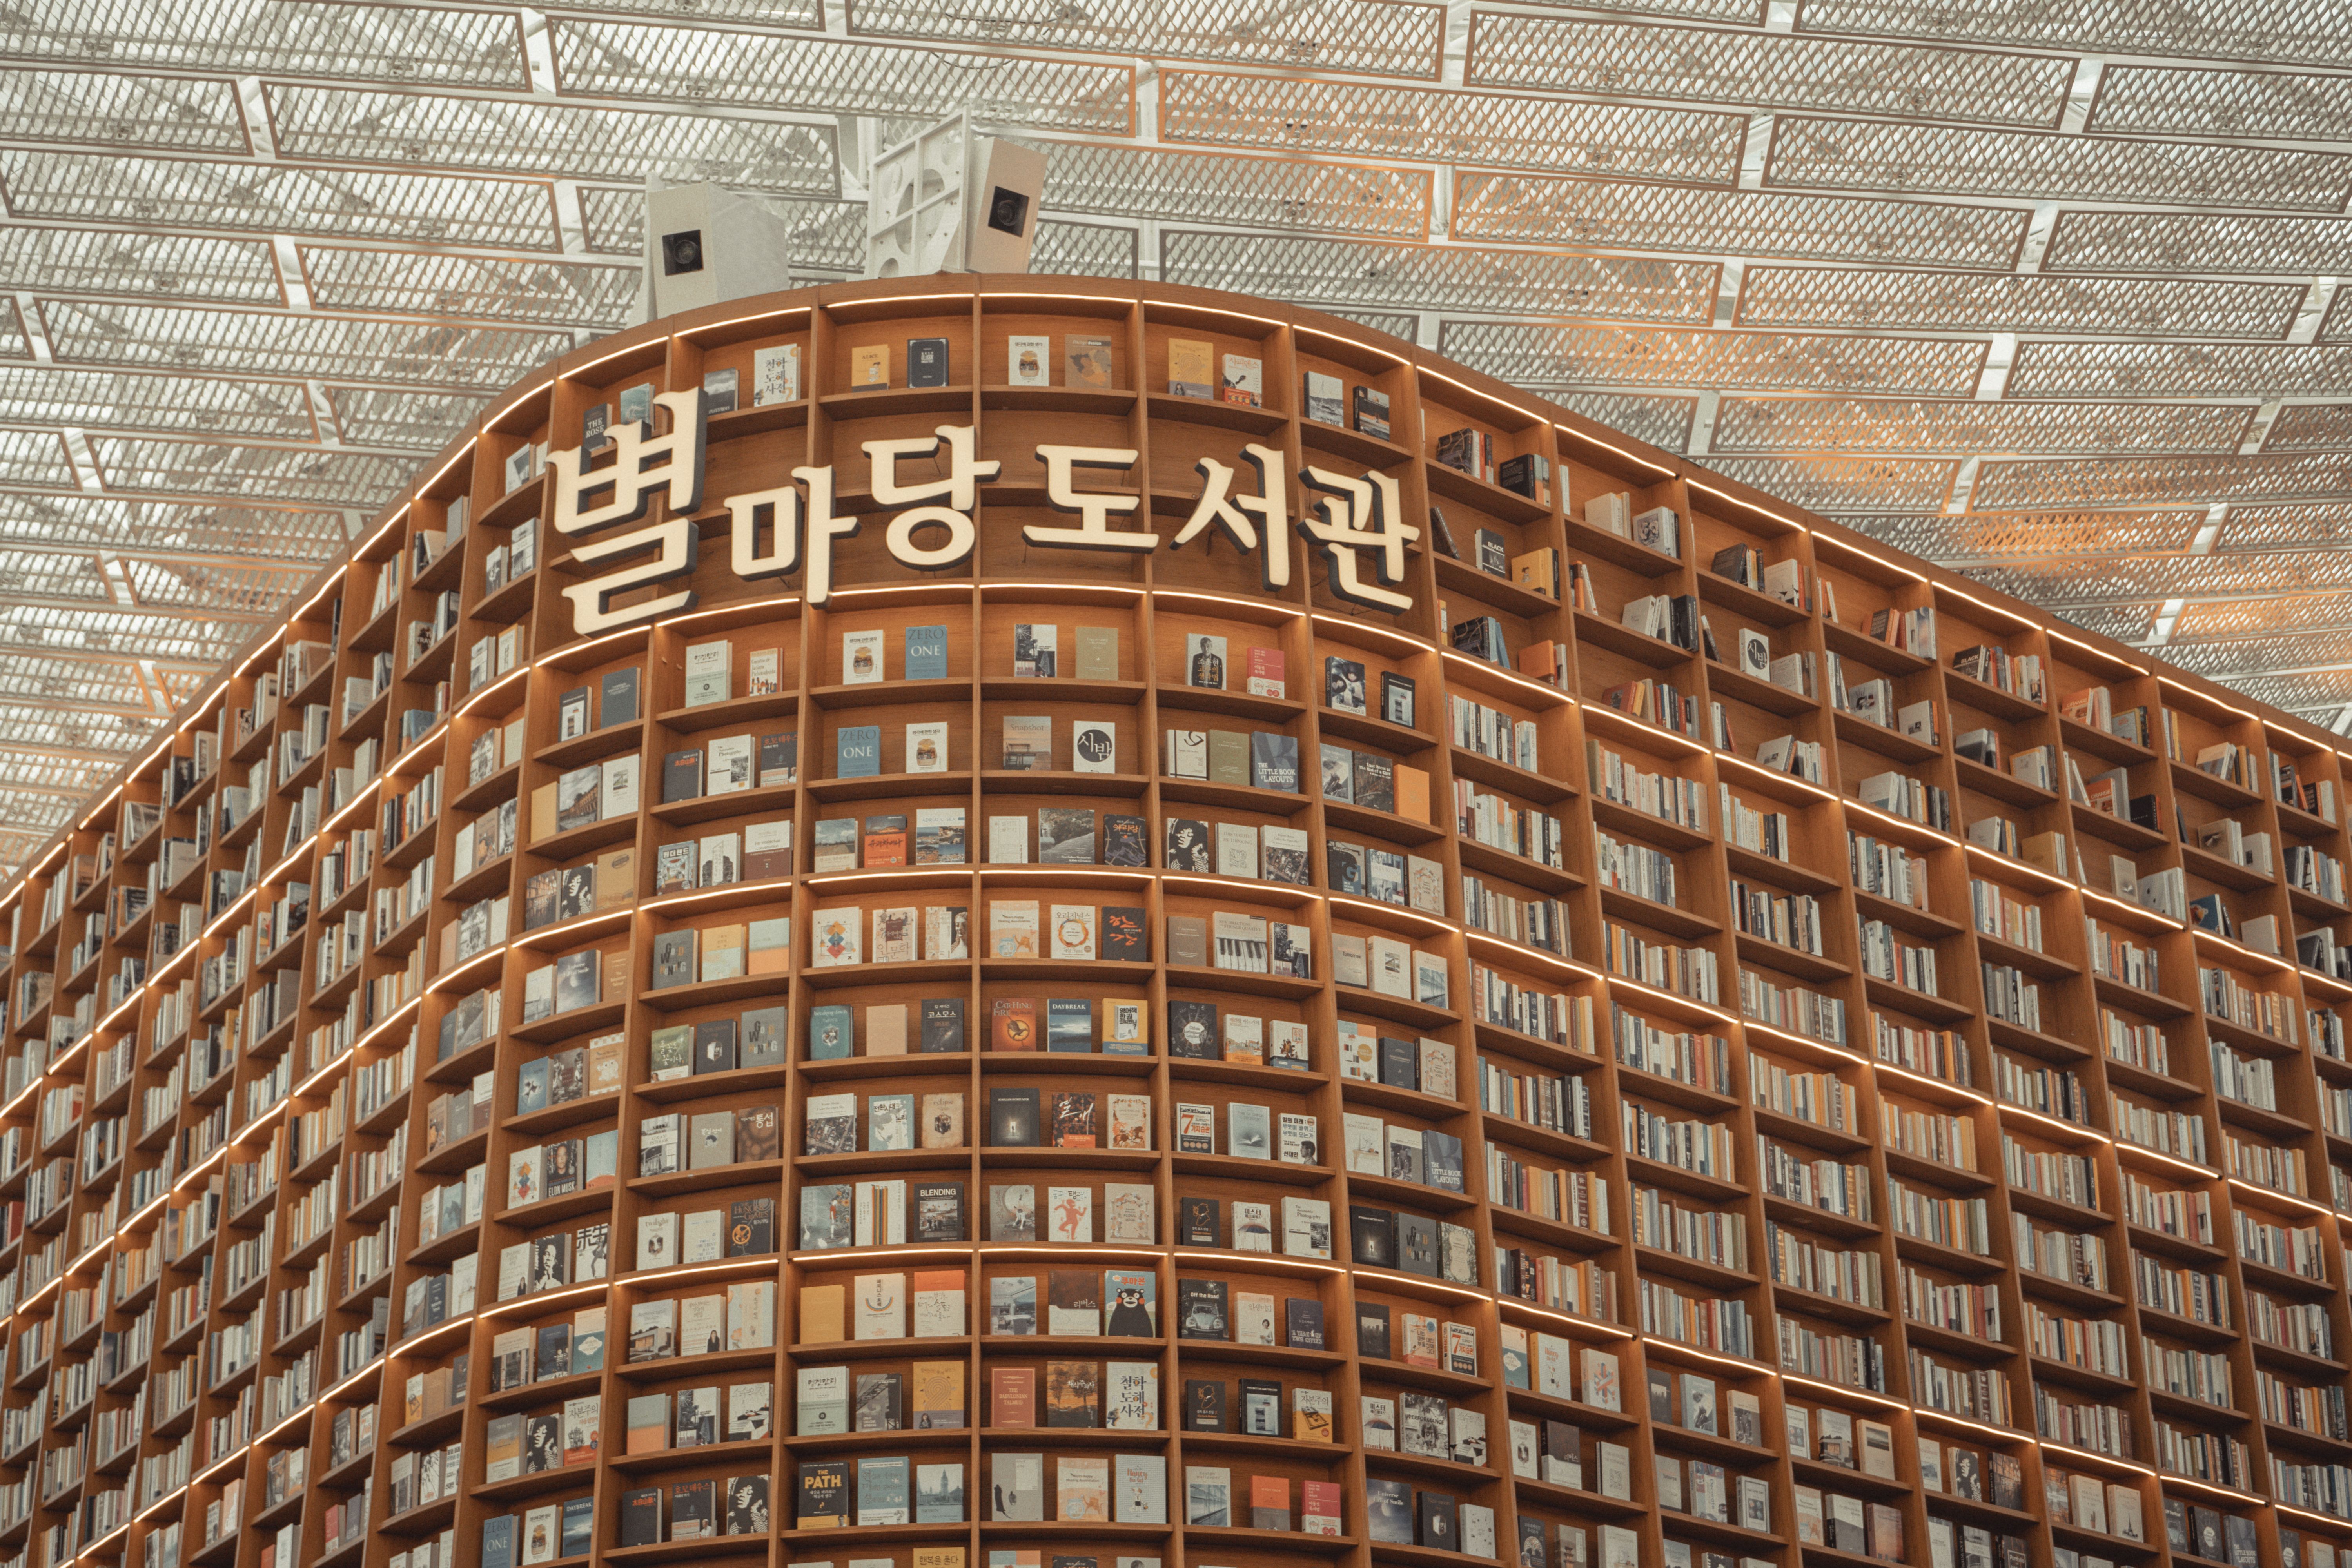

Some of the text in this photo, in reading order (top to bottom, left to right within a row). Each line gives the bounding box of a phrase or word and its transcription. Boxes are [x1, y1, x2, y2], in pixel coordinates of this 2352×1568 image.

[1229, 357, 1259, 369] 사피엔스
[588, 418, 603, 429] THE
[585, 425, 604, 439] ROSE
[1488, 541, 1504, 553] BLACK
[908, 628, 944, 641] ZERO
[911, 645, 940, 657] ONE
[1961, 654, 1979, 664] BLACK
[2067, 698, 2087, 708] ORANGE
[1347, 707, 1365, 715] CANDLE
[1010, 724, 1044, 732] Snapshot
[840, 730, 877, 742] ZERO
[843, 747, 873, 758] ONE
[2091, 789, 2111, 799] ORANGE
[1055, 911, 1091, 920] 오리지널스
[814, 1009, 834, 1017] breaking
[756, 1112, 773, 1129] 통섭
[1181, 1113, 1194, 1134] 7
[1432, 1168, 1447, 1176] LITTLE
[1436, 1176, 1460, 1185] LAYOUTS
[548, 1181, 575, 1197] ELON MUSK
[920, 1188, 956, 1196] BLENDING
[645, 1218, 669, 1228] twilight
[1121, 1276, 1146, 1286] 쿠마몬
[1073, 1298, 1096, 1308] 리버스
[1451, 1334, 1461, 1355] 7
[1120, 1375, 1147, 1390] 철학
[1120, 1390, 1145, 1404] 도해
[1301, 1395, 1329, 1407] 자본주의
[568, 1403, 598, 1420] 자본주의
[1120, 1403, 1146, 1418] 사전
[1408, 1414, 1445, 1425] PERFORMANCE
[804, 1475, 842, 1490] PATH
[674, 1485, 689, 1494] 호모
[566, 1501, 592, 1512] DAYBREAK
[486, 1517, 511, 1534] ZERO
[486, 1536, 508, 1552] ONE
[919, 1555, 959, 1566] 행복을 풀다
[2009, 1554, 2025, 1563] Portfolio
